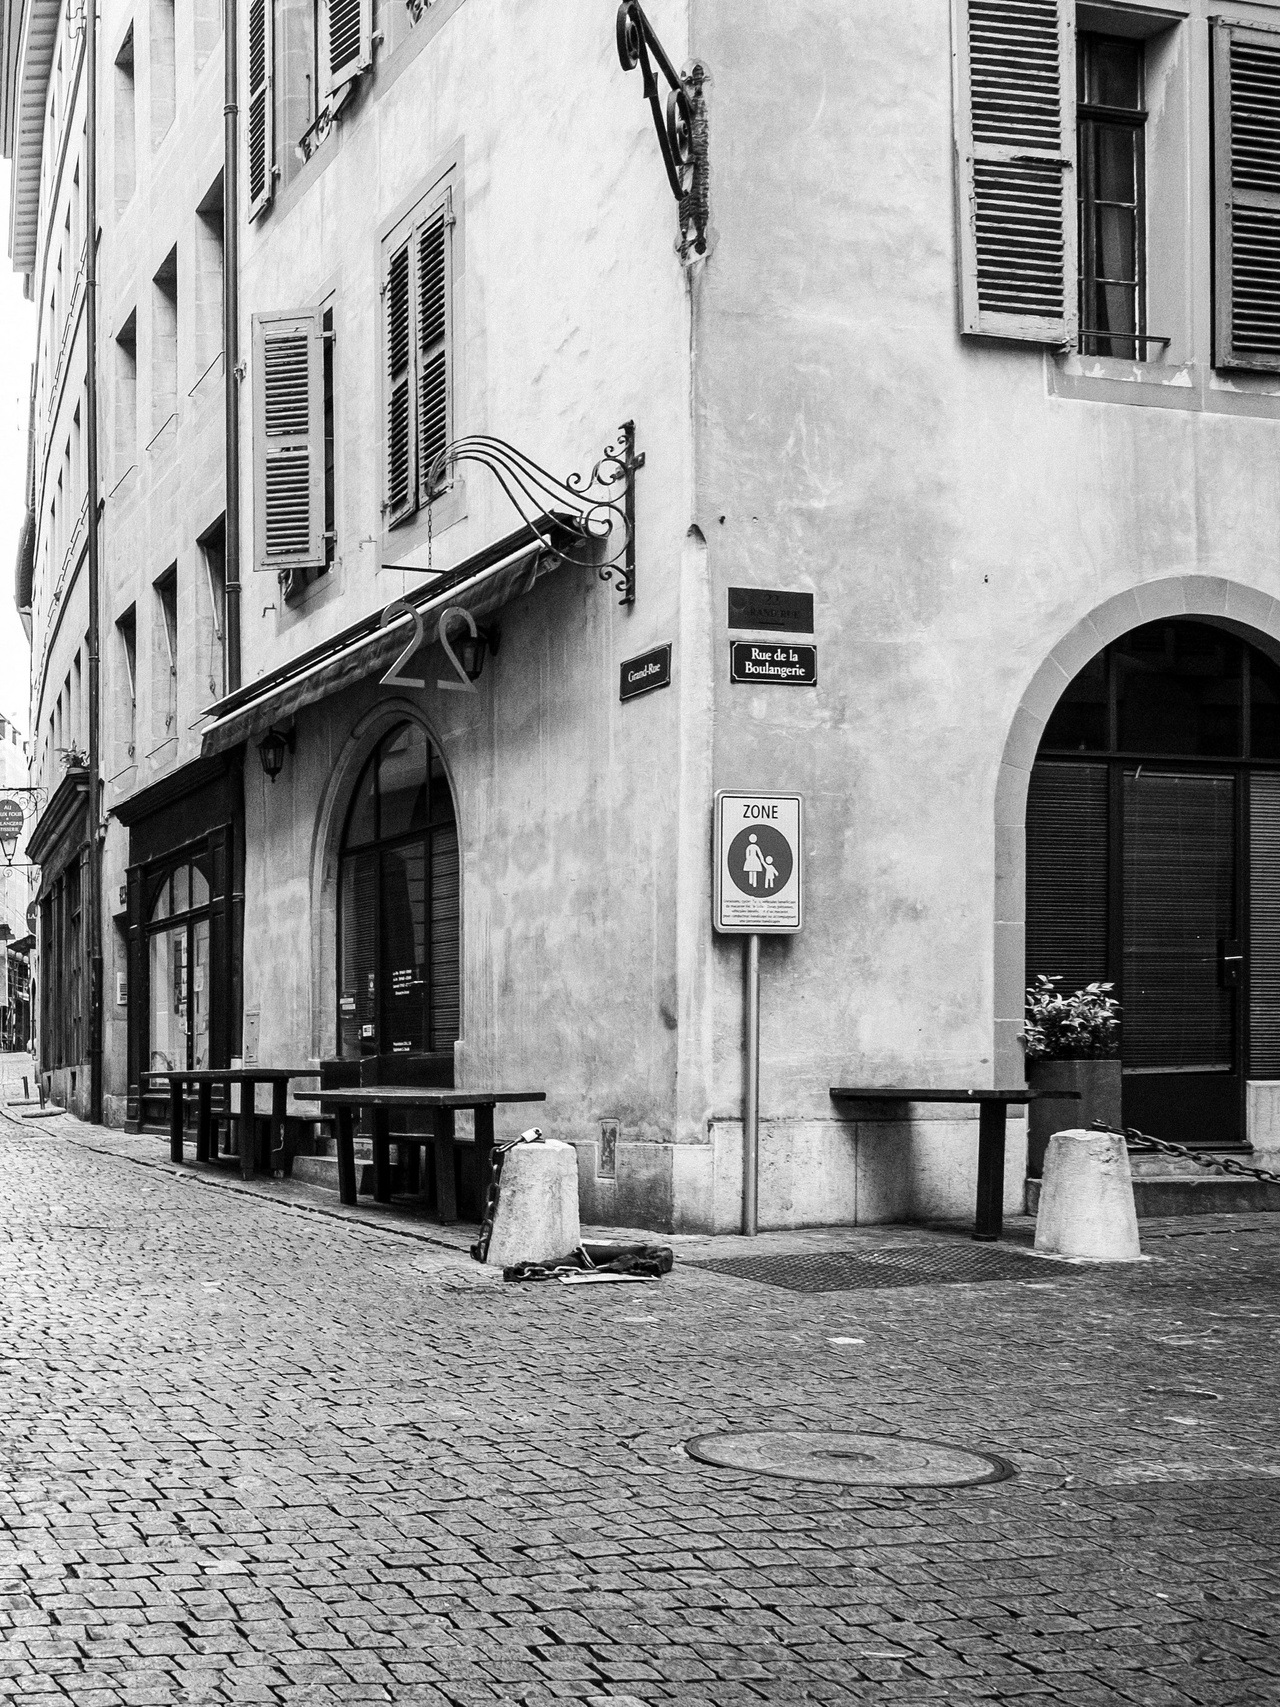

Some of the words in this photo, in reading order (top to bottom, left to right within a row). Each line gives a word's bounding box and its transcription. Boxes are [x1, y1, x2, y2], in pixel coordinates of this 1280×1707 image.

[751, 648, 772, 660] Rue
[773, 649, 787, 661] de
[789, 649, 799, 662] la
[628, 663, 661, 682] Grand-Rue
[745, 661, 806, 678] Boulangerie
[743, 804, 779, 819] ZONE
